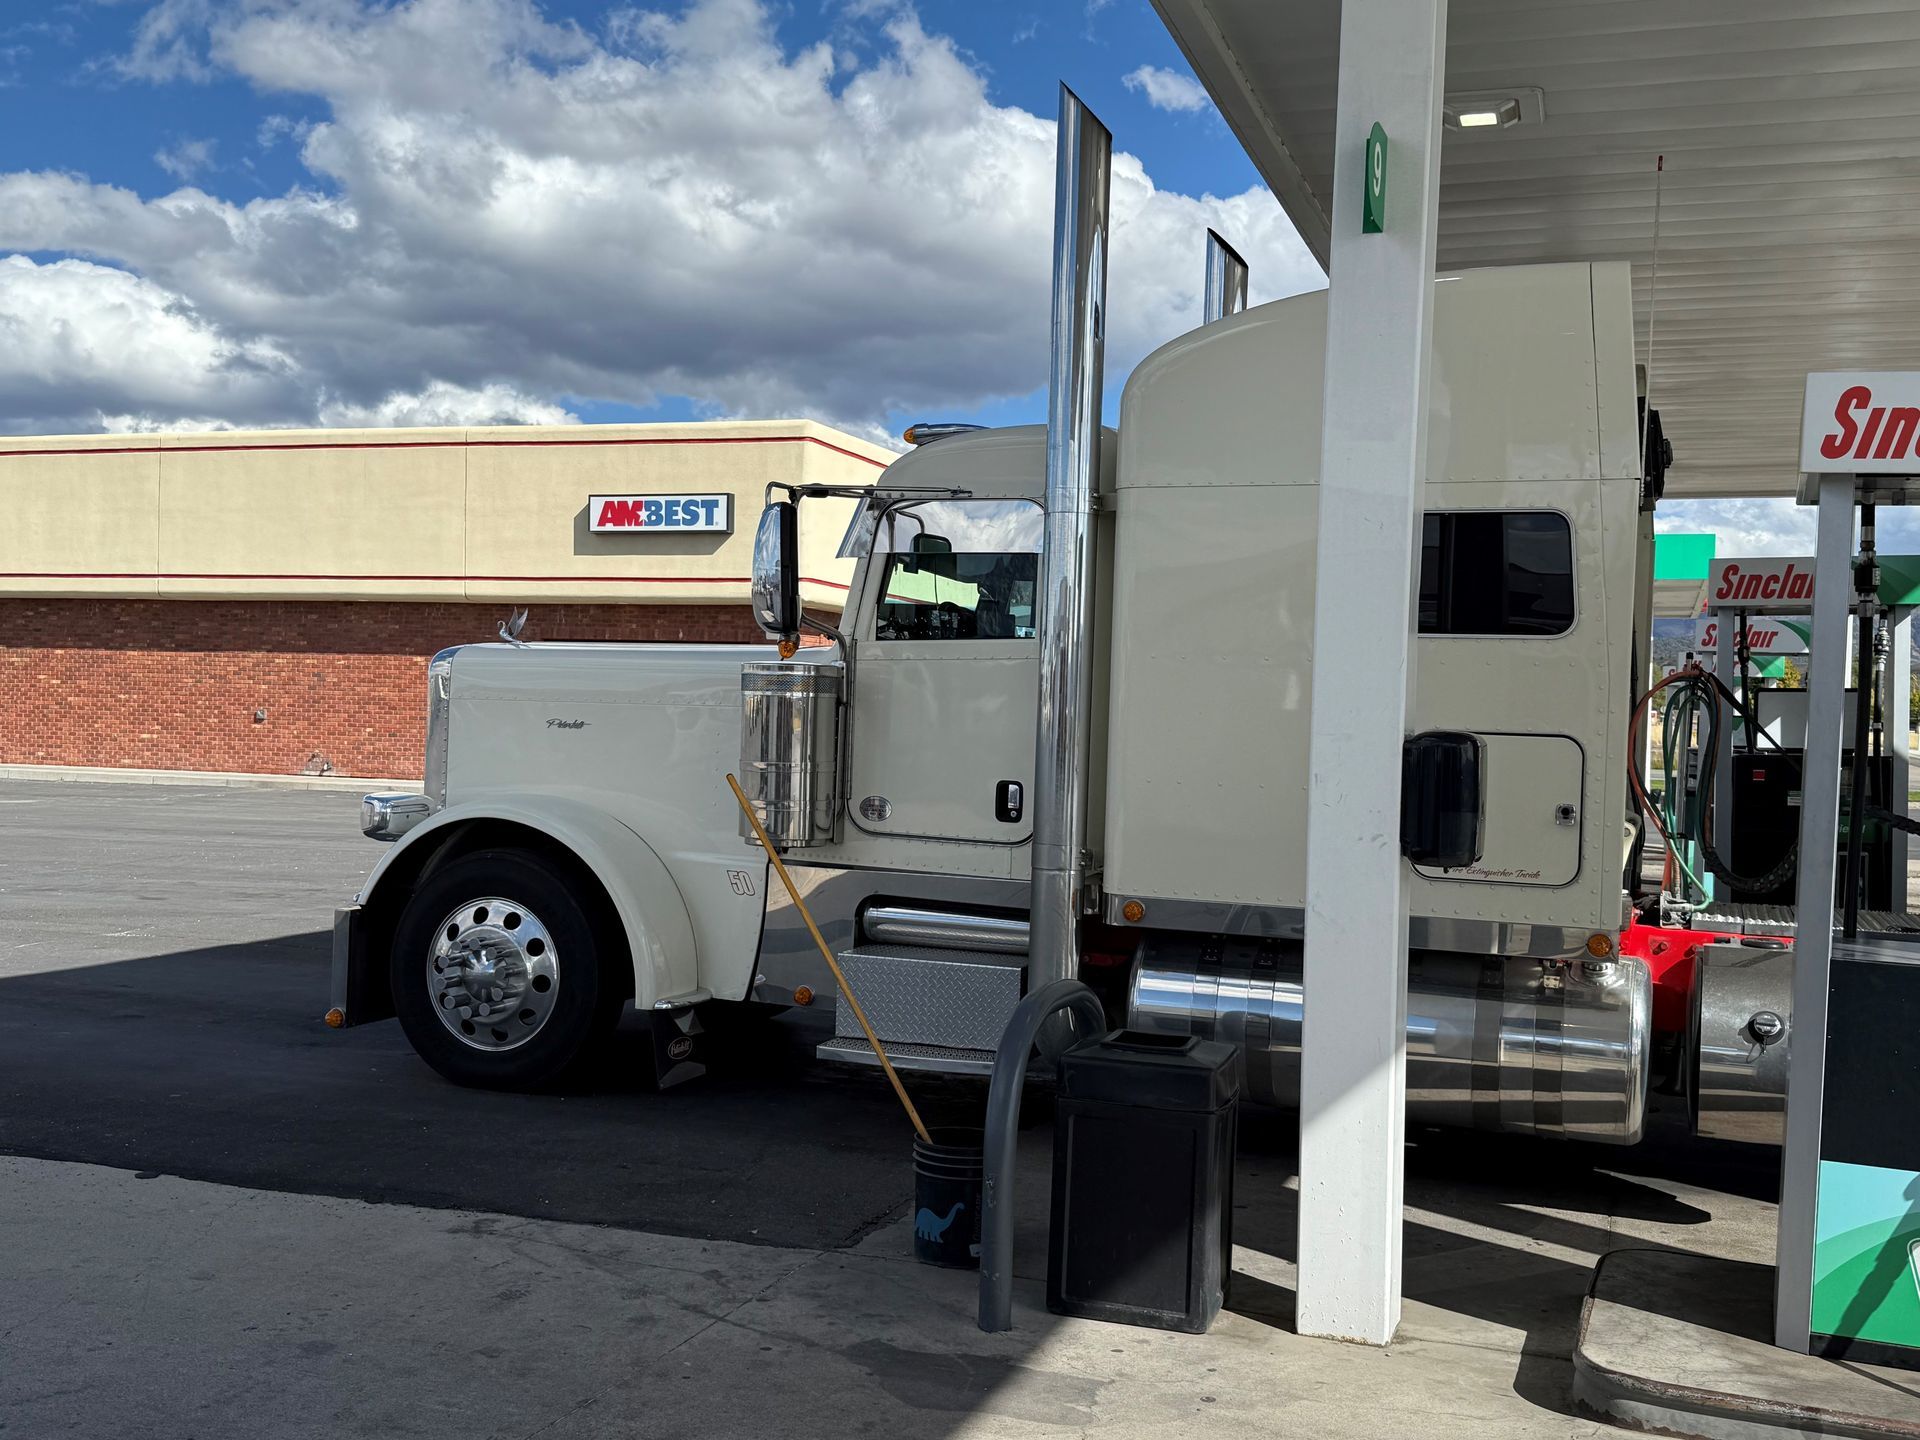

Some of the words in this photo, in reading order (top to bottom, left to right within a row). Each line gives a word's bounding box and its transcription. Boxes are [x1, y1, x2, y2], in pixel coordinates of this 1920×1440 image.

[1374, 142, 1382, 197] 9
[1820, 385, 1920, 460] Sin
[597, 499, 720, 527] AMBEST
[1716, 563, 1814, 600] Sinclai
[1701, 623, 1779, 648] Siclair
[726, 869, 756, 897] 50
